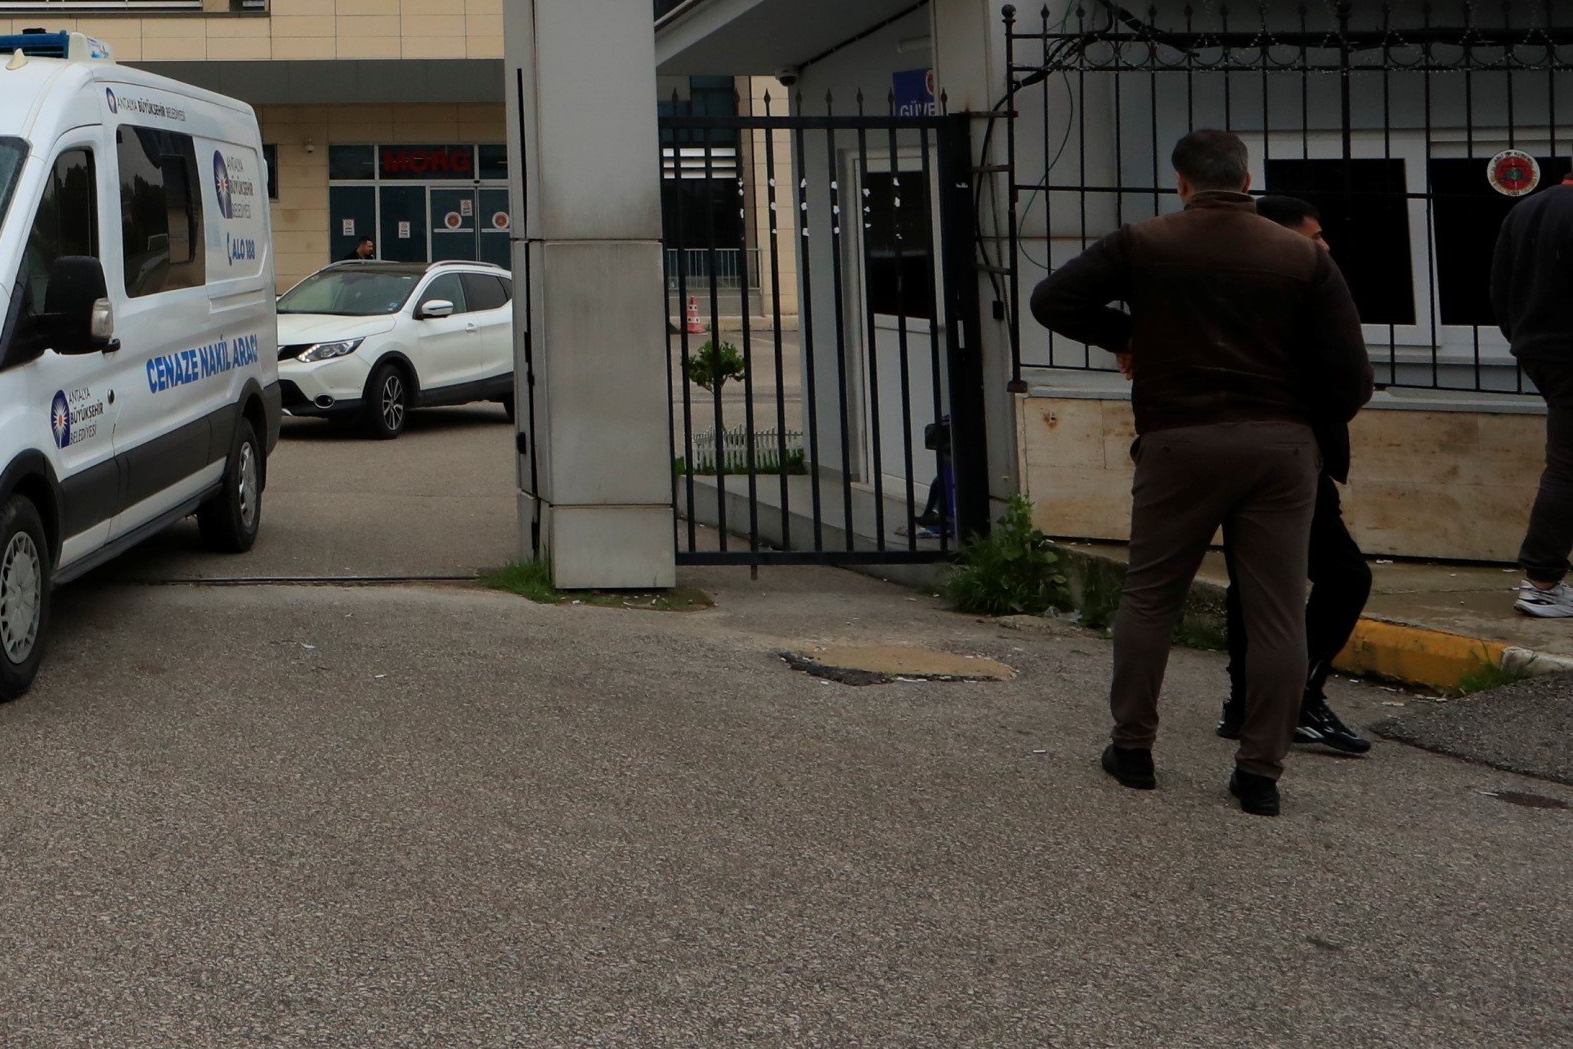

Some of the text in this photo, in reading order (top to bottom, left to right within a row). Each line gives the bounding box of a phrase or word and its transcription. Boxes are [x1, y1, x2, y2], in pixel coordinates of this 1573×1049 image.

[383, 150, 471, 173] MORG
[146, 334, 258, 394] CENAZE NAKİL ARACI
